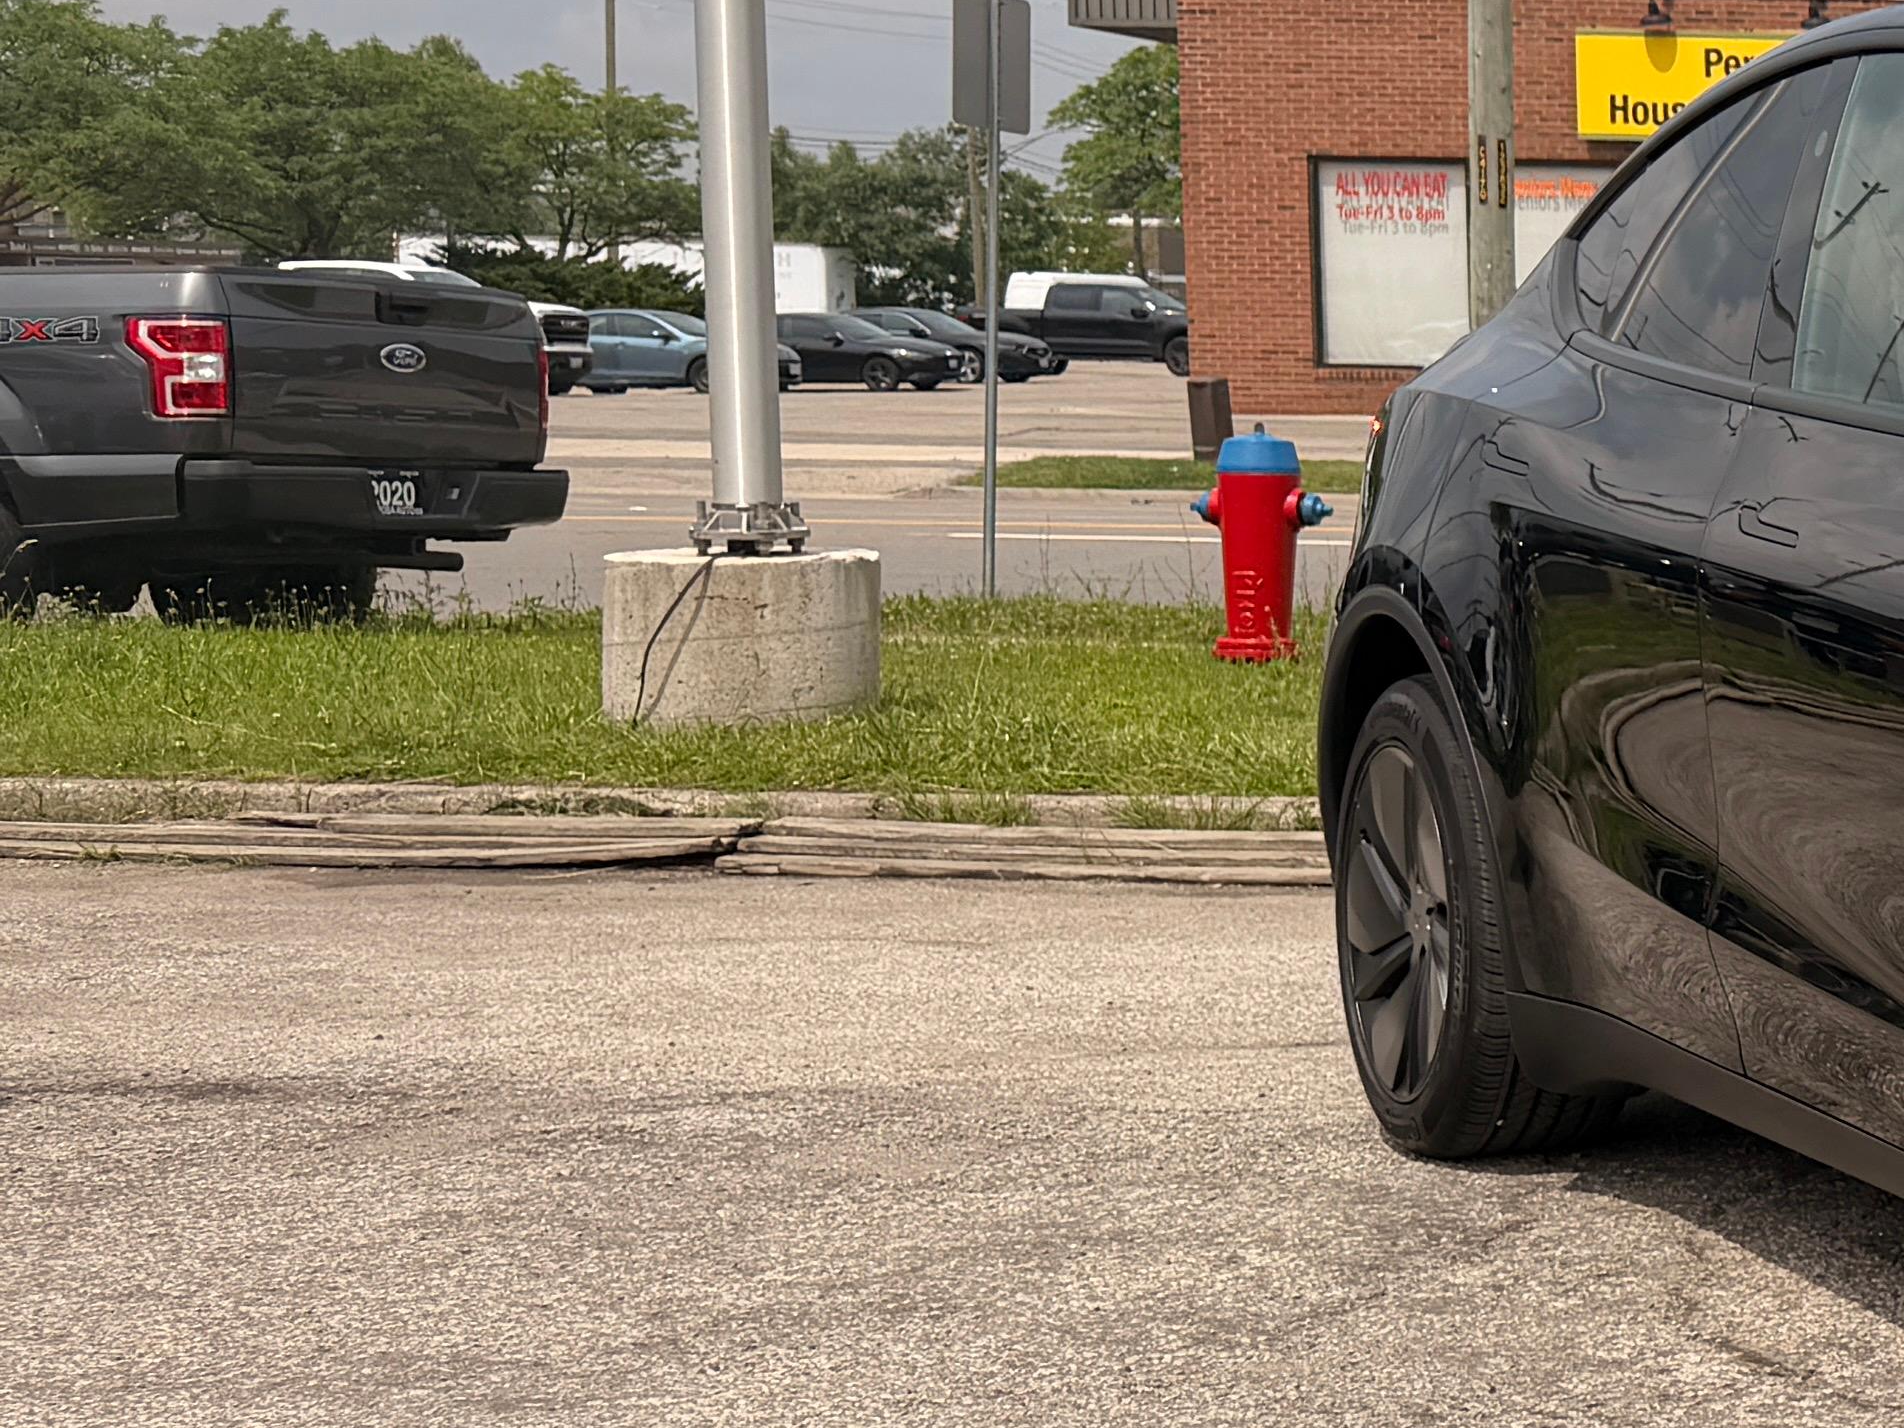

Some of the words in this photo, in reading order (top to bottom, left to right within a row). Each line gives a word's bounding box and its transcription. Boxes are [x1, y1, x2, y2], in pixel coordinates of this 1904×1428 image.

[1336, 172, 1360, 197] ALL
[1363, 171, 1391, 198] YOU
[1394, 172, 1420, 198] CAN
[1424, 172, 1448, 199] EAT
[1387, 204, 1395, 221] 3
[1400, 206, 1413, 221] to
